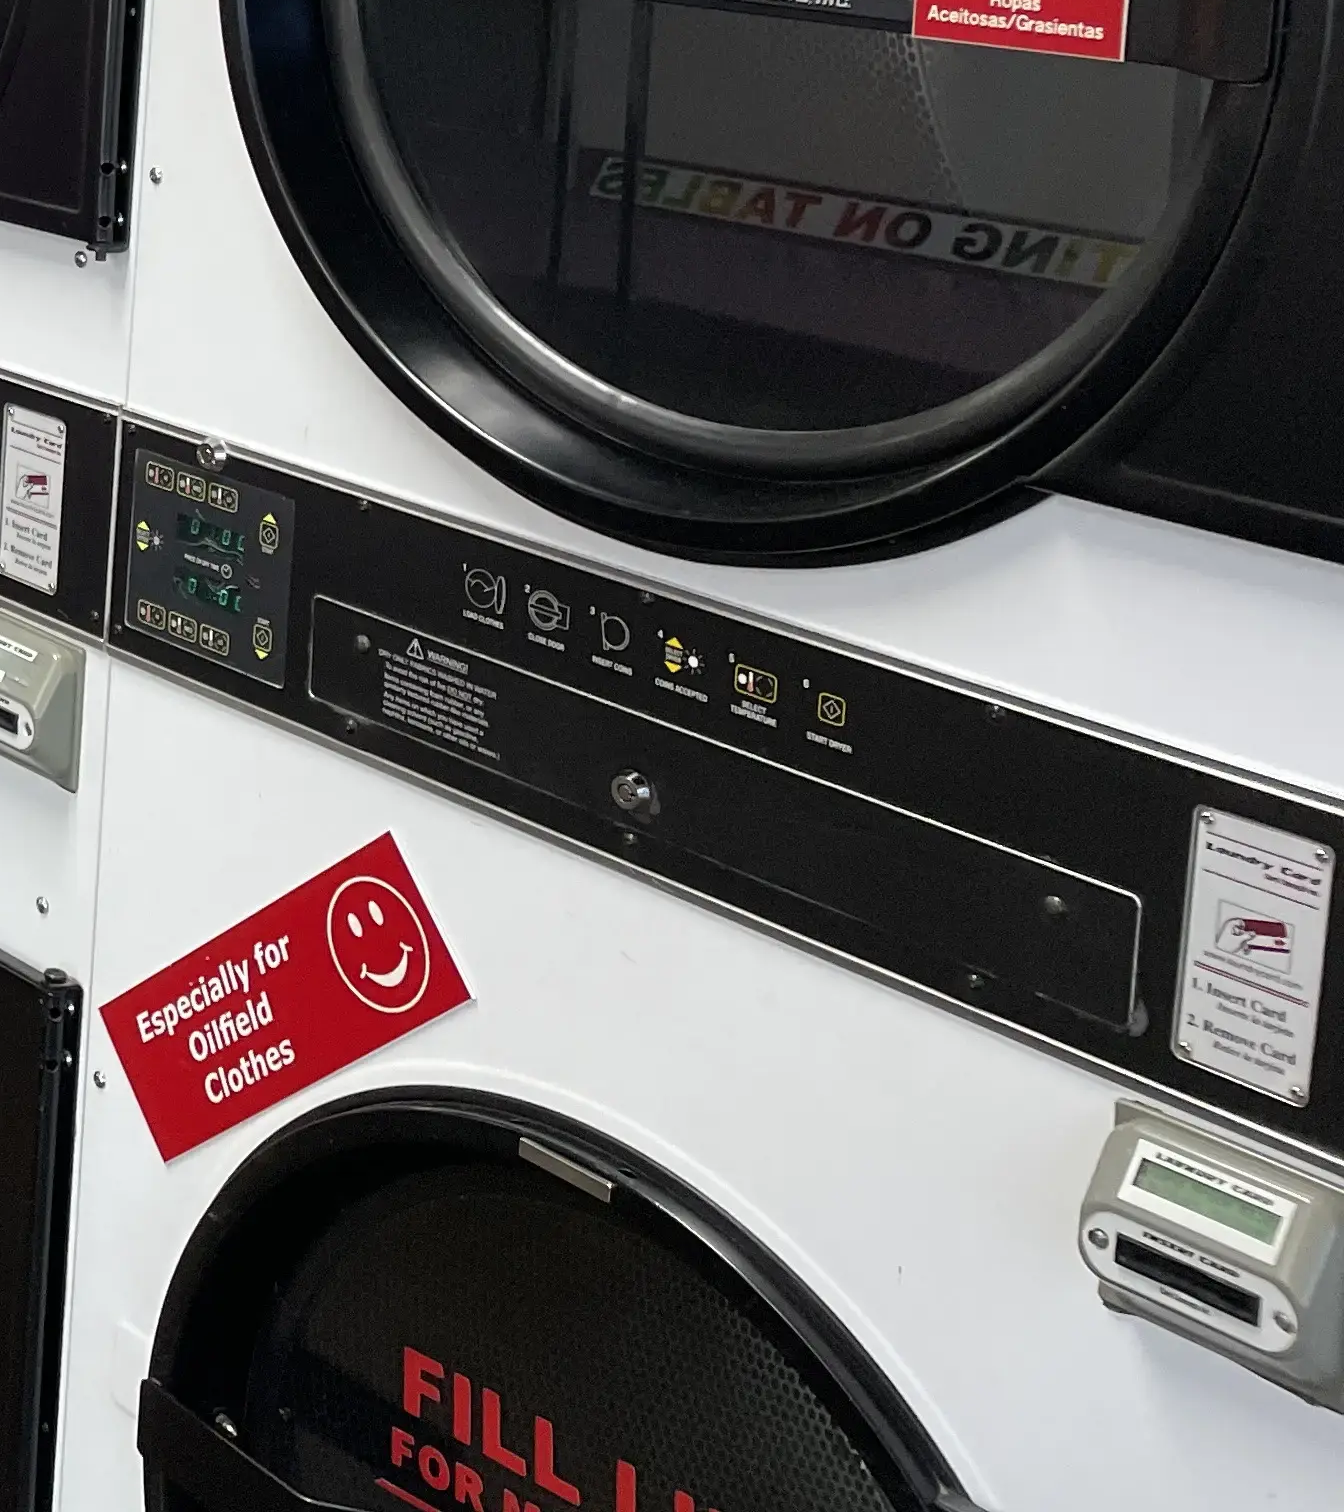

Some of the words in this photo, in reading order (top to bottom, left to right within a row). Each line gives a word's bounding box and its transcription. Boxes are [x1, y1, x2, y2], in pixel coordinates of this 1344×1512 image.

[925, 3, 1106, 41] Aceitosas/Grasientas
[136, 959, 251, 1044] Especially
[253, 934, 291, 976] for
[1206, 981, 1247, 1009] Insert
[1251, 999, 1288, 1023] Card
[187, 990, 275, 1063] Oilfield
[1202, 1018, 1257, 1050] Remove
[1259, 1041, 1297, 1066] Card
[202, 1038, 297, 1105] Clothes
[402, 1345, 581, 1507] FILL
[389, 1425, 485, 1512] FOR
